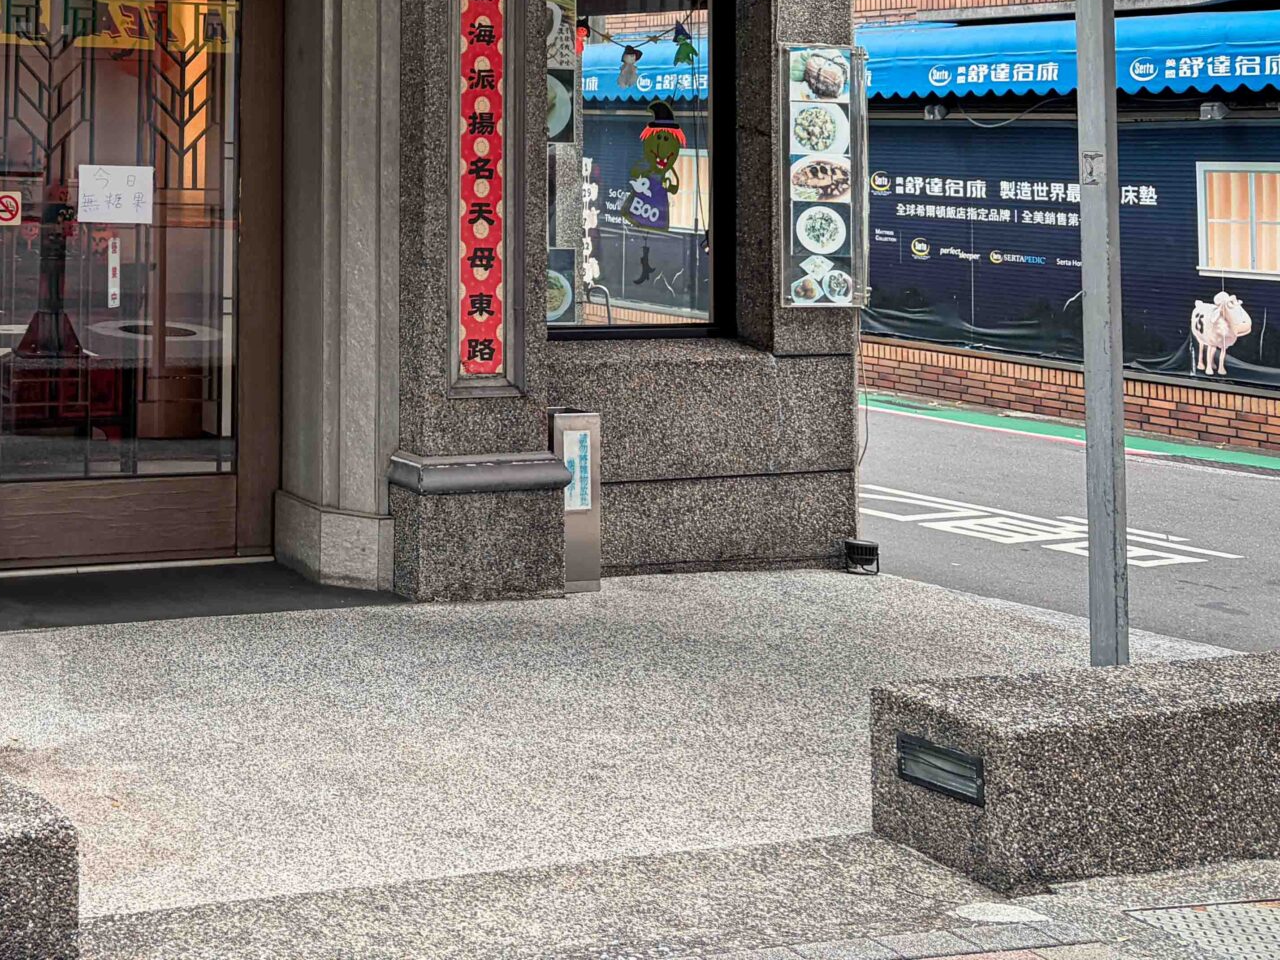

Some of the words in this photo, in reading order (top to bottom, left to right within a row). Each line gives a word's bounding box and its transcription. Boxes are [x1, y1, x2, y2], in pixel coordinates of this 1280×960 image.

[93, 167, 137, 190] 今日
[80, 191, 147, 214] 無糖果
[1120, 185, 1158, 206] 床墊
[629, 197, 660, 223] BOO
[1021, 210, 1082, 227] 全美銷售第
[1003, 253, 1047, 265] SERTAPEDIC
[1056, 258, 1072, 267] Serta
